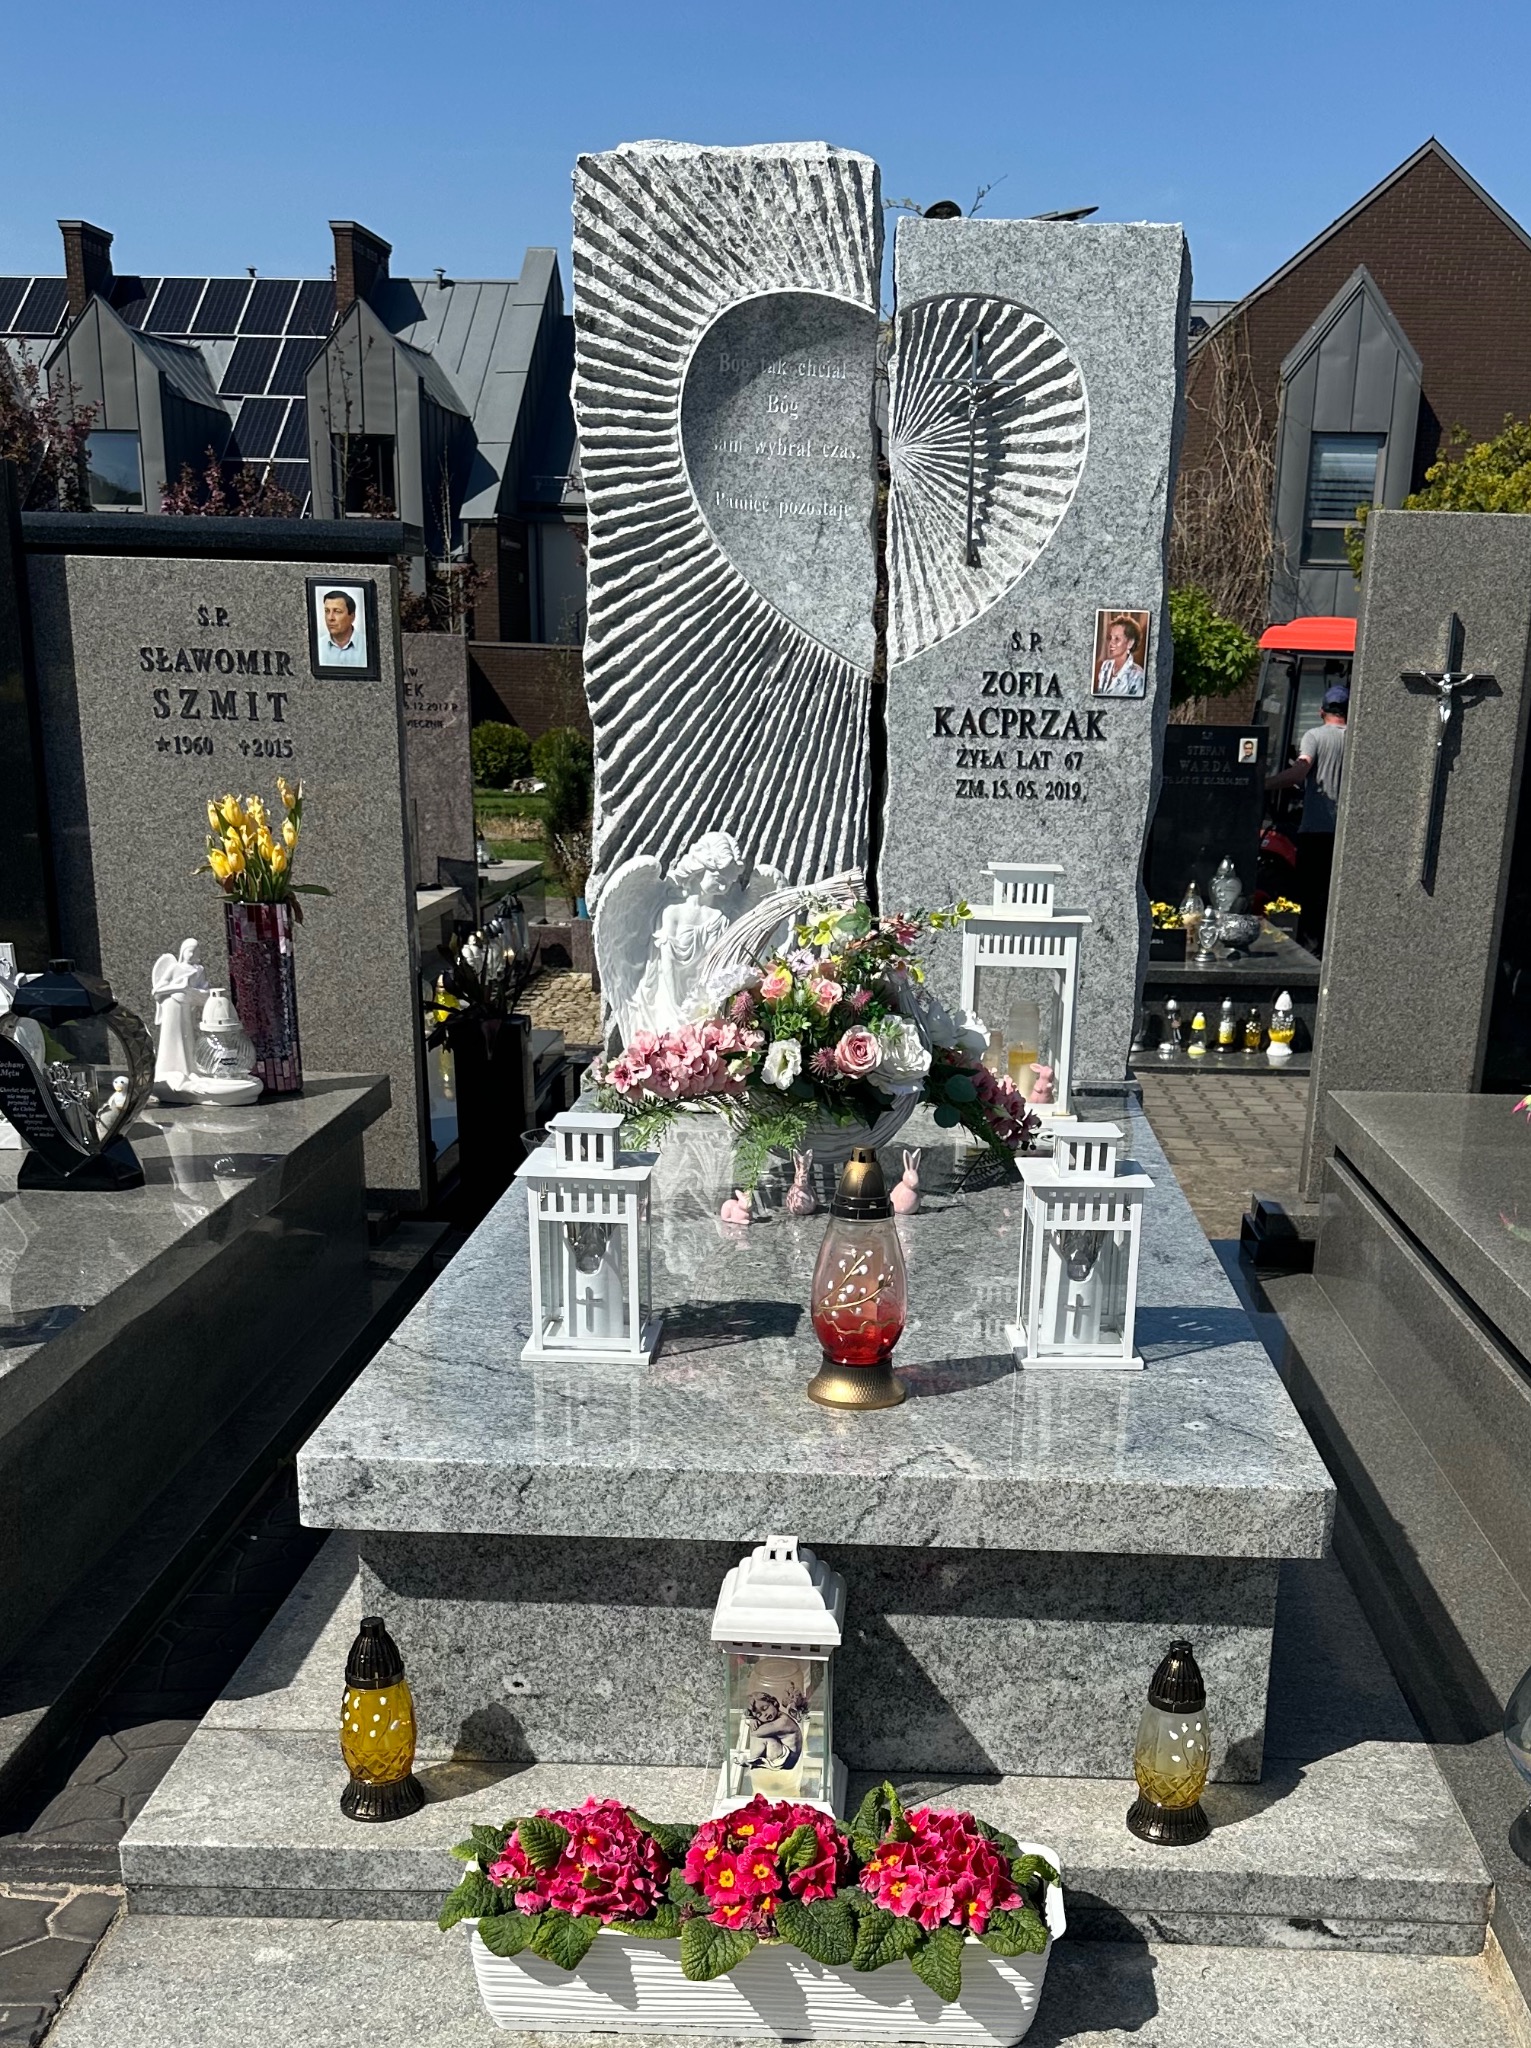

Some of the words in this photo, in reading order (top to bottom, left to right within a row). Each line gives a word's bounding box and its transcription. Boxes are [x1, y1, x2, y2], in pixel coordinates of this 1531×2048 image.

[761, 356, 787, 376] tak
[766, 394, 799, 420] Bóg
[779, 499, 852, 522] pozostaje
[140, 647, 294, 676] SŁAWOMIR
[981, 671, 1064, 698] ZOFIA
[153, 688, 289, 723] SZMIT
[933, 707, 1107, 741] KACPRZAK
[956, 744, 1007, 769] ŻYŁA
[1017, 750, 1053, 770] LAT
[1064, 751, 1084, 771] 67
